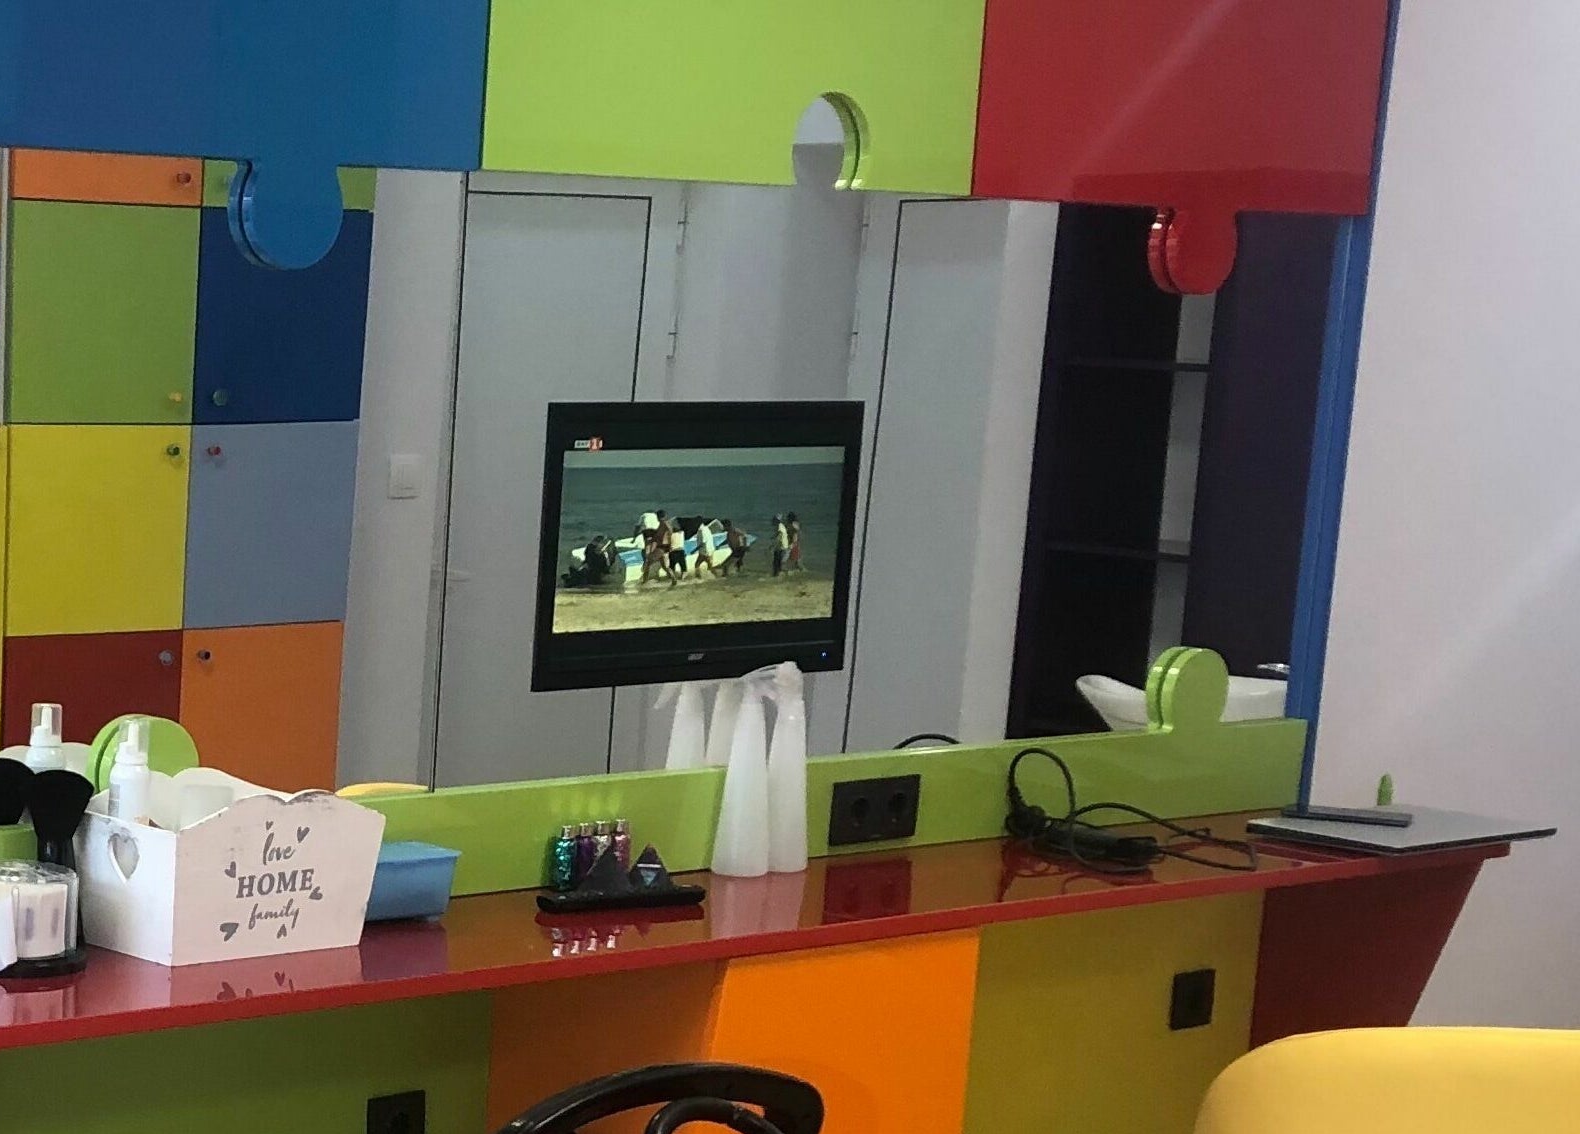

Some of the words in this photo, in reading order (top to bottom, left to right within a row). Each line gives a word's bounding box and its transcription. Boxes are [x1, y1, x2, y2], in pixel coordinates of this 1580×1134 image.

[262, 832, 296, 866] love
[236, 868, 315, 899] HOME
[248, 898, 300, 930] family
